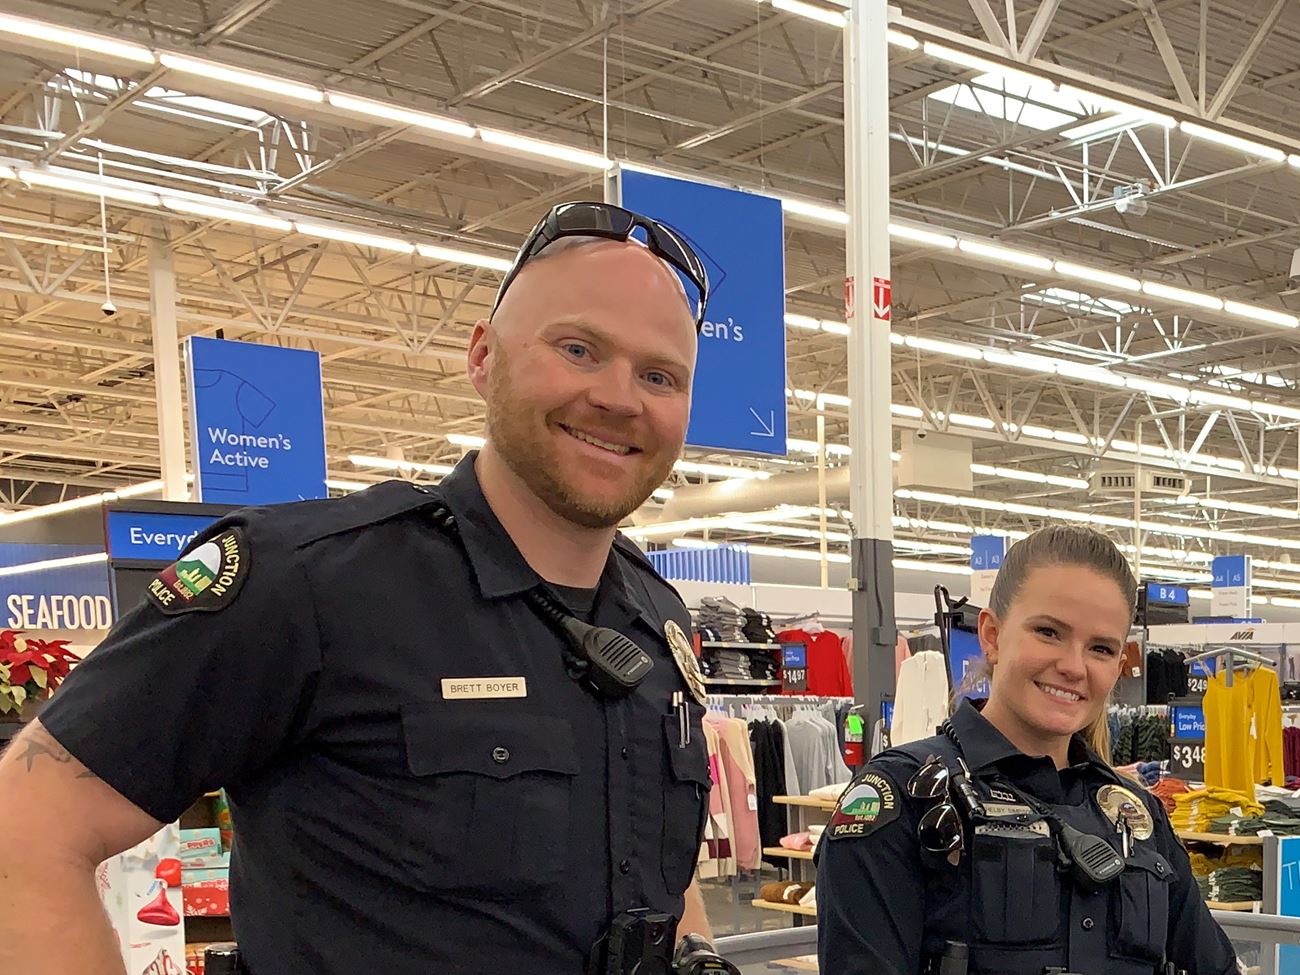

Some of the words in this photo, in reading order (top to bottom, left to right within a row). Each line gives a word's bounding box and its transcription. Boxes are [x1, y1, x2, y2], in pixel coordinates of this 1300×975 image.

[701, 317, 744, 342] en's
[208, 426, 292, 452] Women's
[209, 449, 270, 470] Active
[129, 527, 200, 551] Everyd
[211, 534, 240, 597] JUNCTION
[148, 578, 176, 606] POLICE
[1159, 587, 1168, 600] B
[1168, 588, 1176, 602] 4
[7, 594, 112, 630] SEAFOOD
[782, 669, 806, 684] $1497
[1187, 677, 1208, 692] $249
[450, 683, 482, 694] BRETT
[486, 682, 519, 692] BOYER
[1178, 721, 1192, 731] Low
[1192, 721, 1206, 731] Pric
[861, 773, 895, 810] JUNCTION
[834, 823, 864, 836] POLICE
